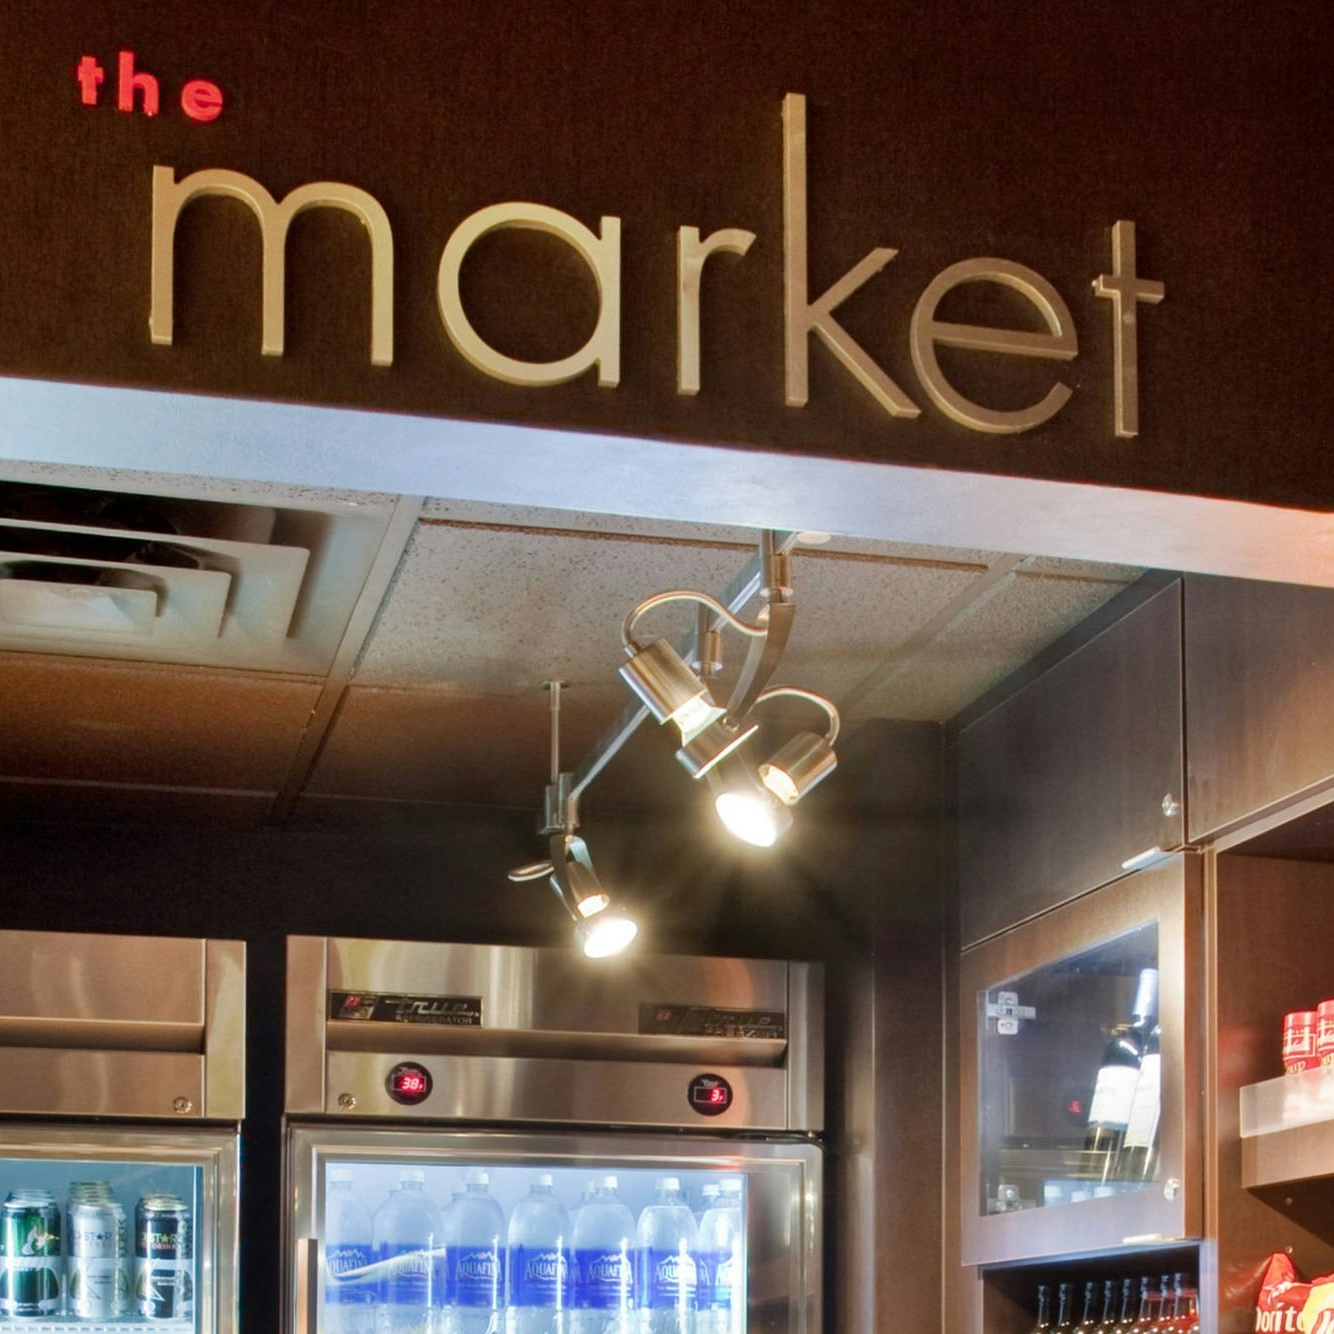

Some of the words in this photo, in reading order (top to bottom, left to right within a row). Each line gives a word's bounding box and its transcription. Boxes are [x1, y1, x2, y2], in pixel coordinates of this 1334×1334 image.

[77, 50, 224, 122] the
[148, 92, 1165, 438] market
[1256, 1302, 1305, 1332] Dorito
